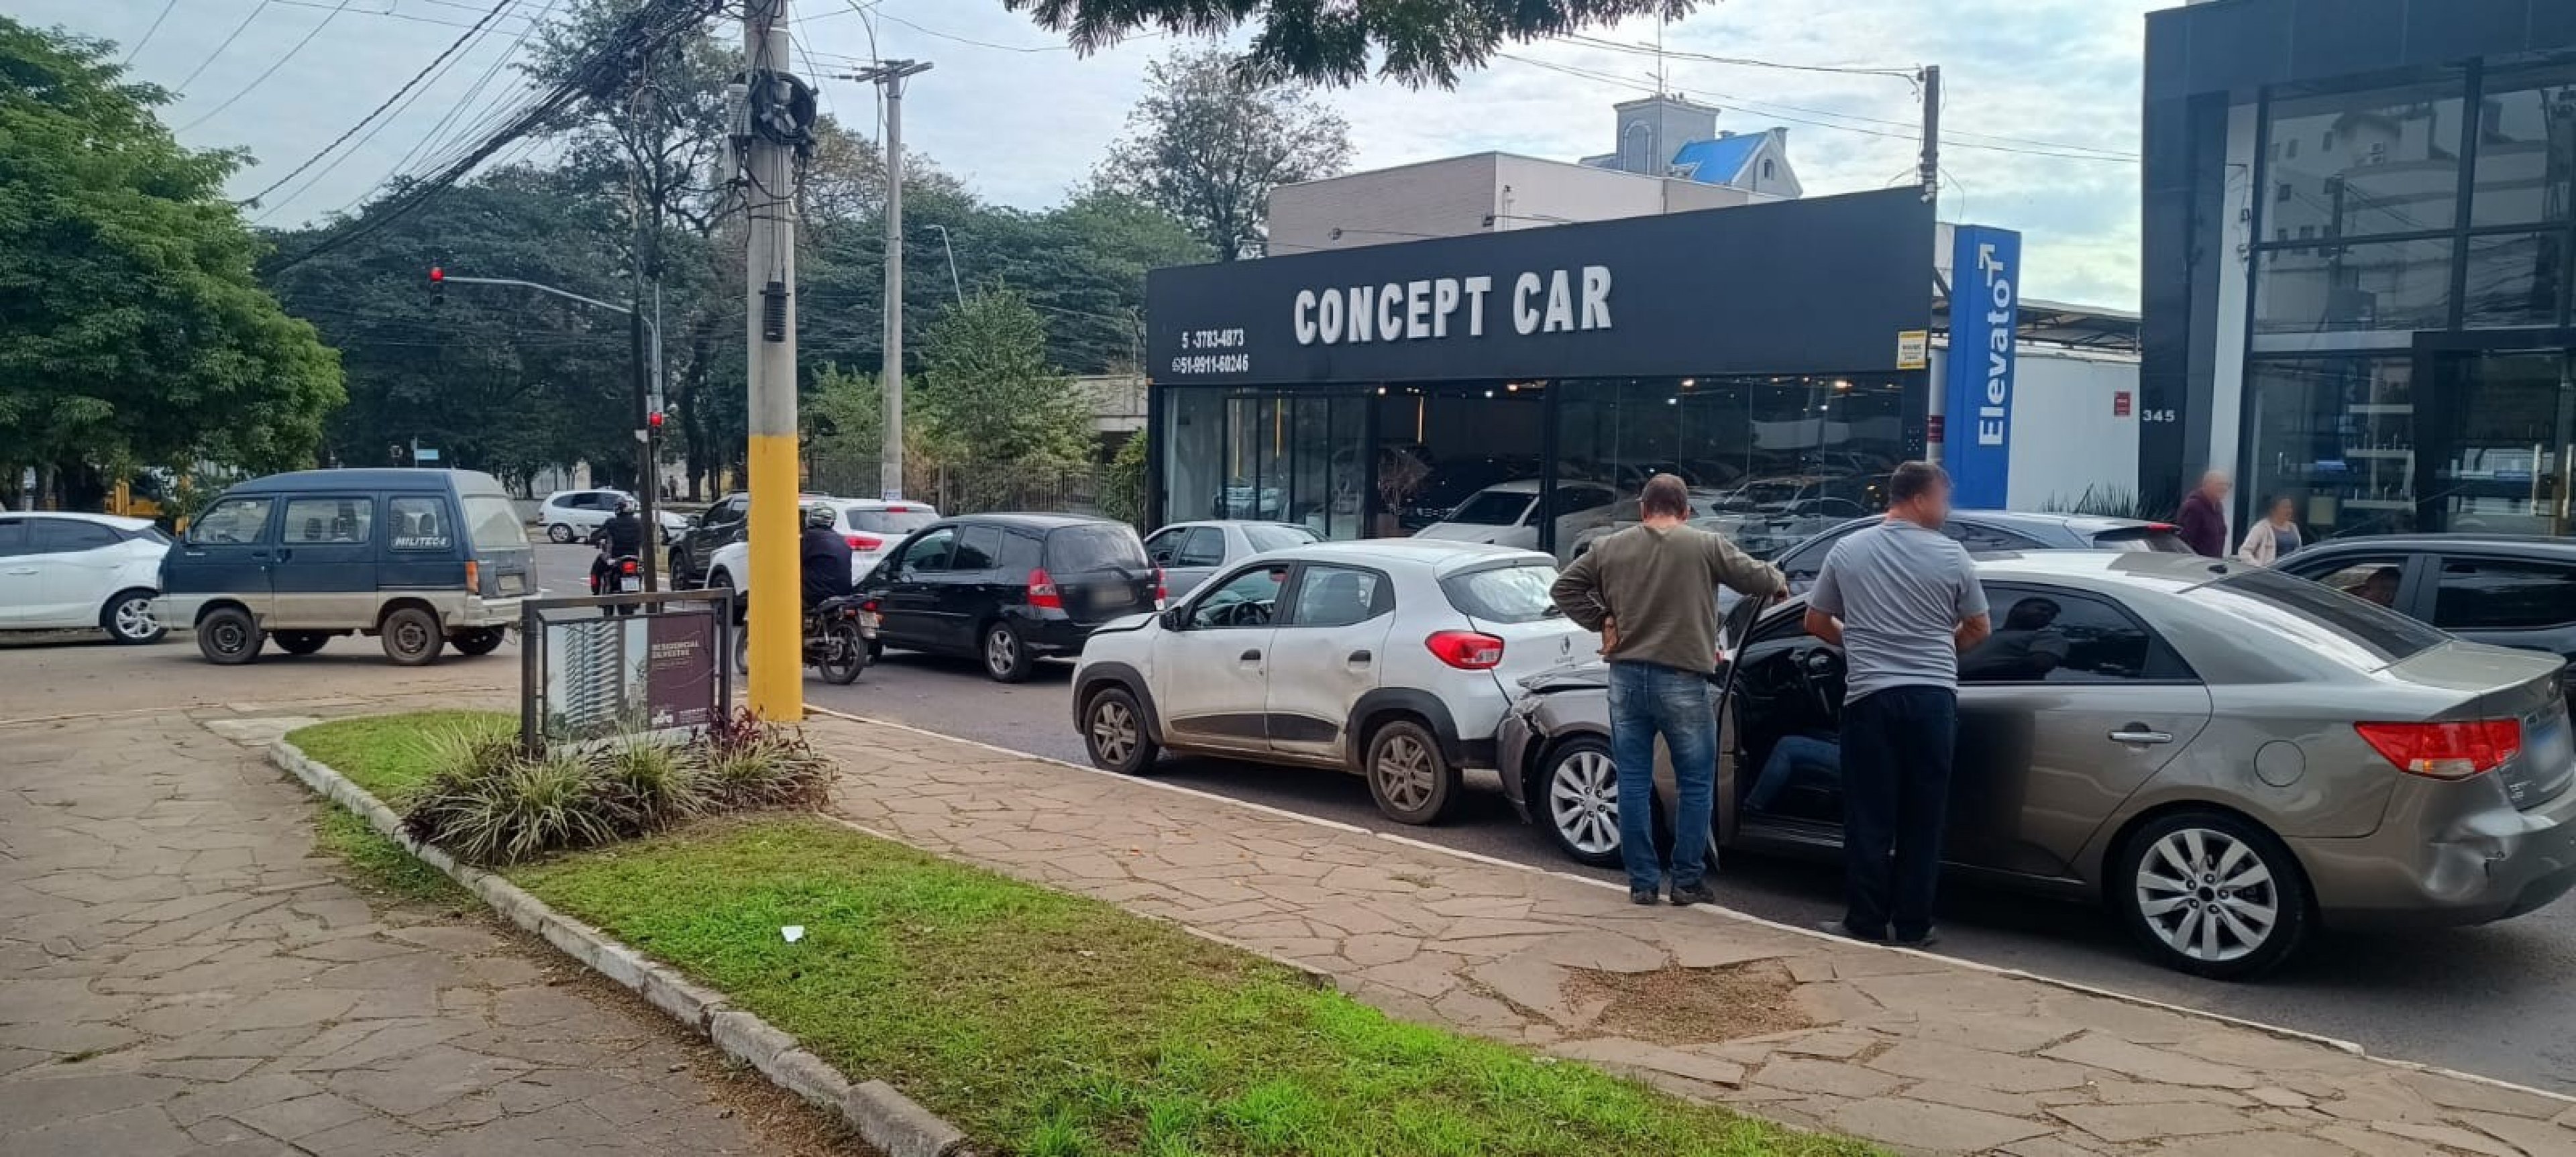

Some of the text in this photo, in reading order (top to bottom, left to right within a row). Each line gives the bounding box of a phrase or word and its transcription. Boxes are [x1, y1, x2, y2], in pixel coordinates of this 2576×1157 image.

[1294, 265, 1612, 345] CONCEPT CAR
[2142, 409, 2175, 423] 345
